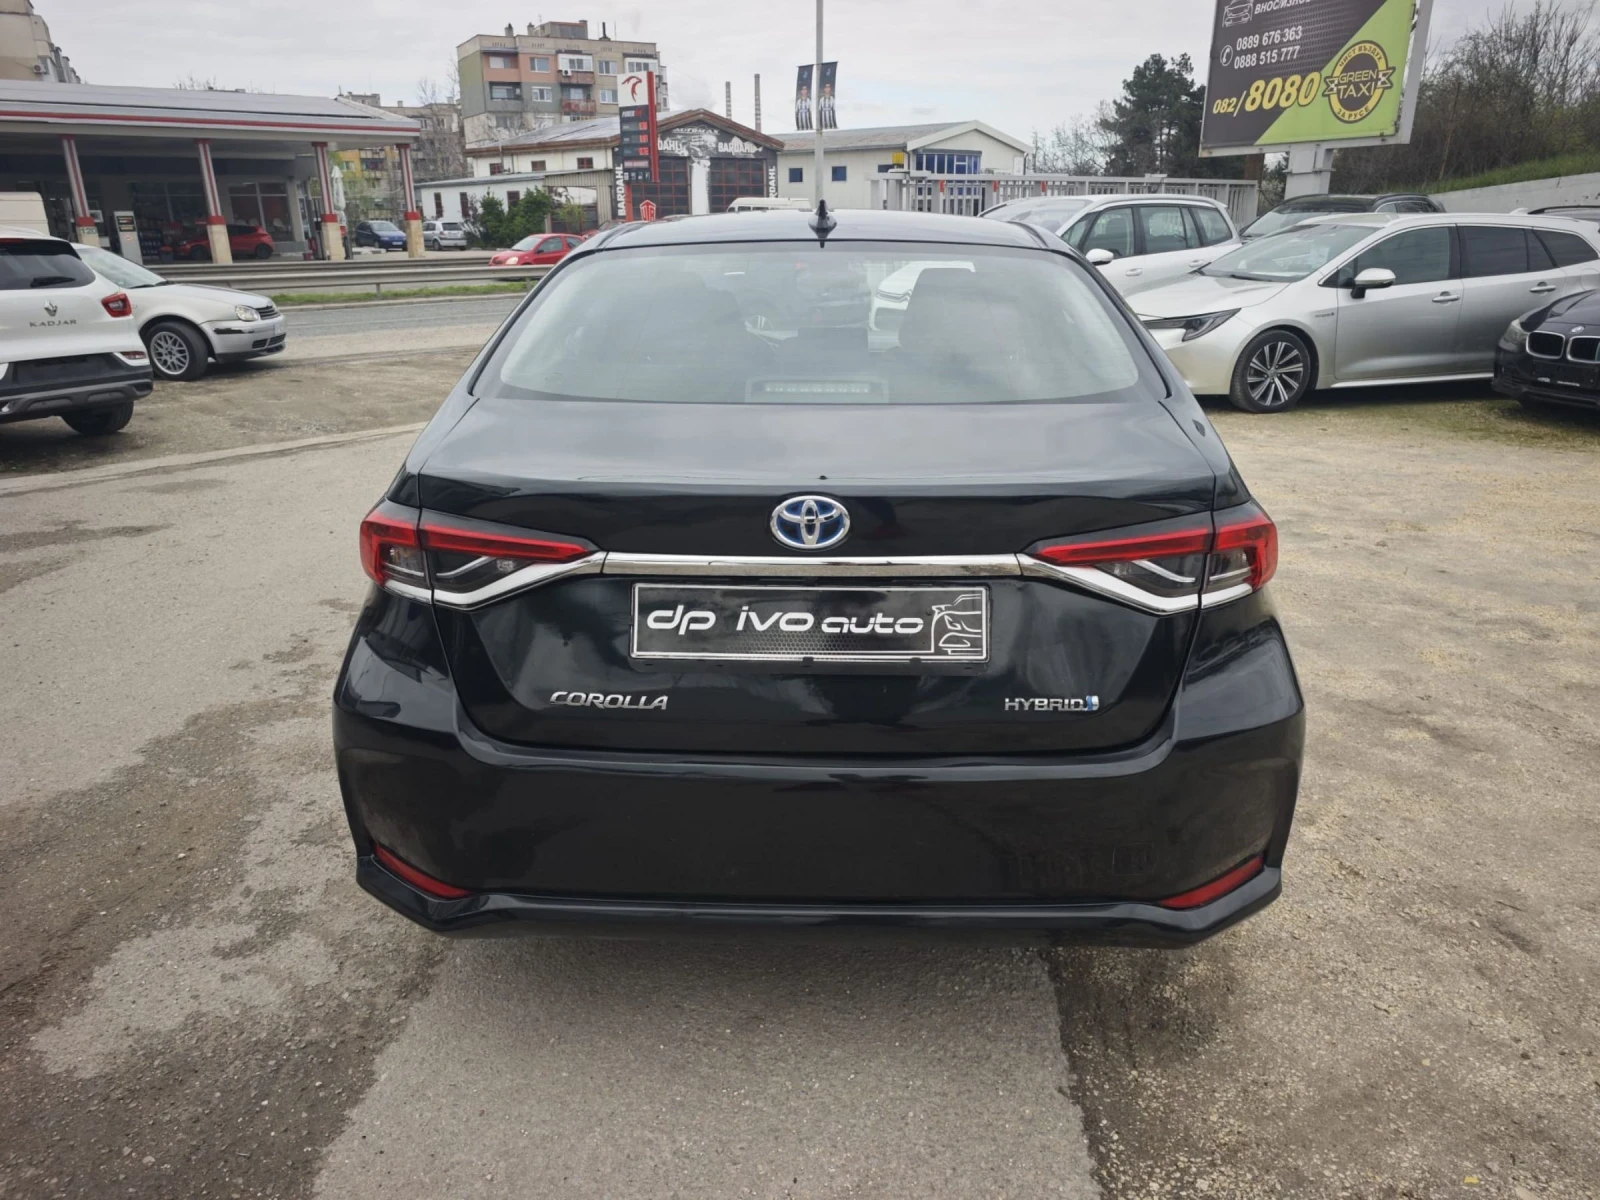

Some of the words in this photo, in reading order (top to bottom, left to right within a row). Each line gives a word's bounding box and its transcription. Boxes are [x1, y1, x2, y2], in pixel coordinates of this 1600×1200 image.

[1254, 0, 1311, 15] ВНОС/ИЗН
[1236, 34, 1259, 51] 0889
[1262, 30, 1281, 46] 676
[1283, 25, 1303, 42] 363
[1234, 53, 1257, 69] 0888
[1259, 49, 1278, 65] 515
[1280, 45, 1300, 61] 777
[1339, 69, 1378, 83] GREEN
[1338, 81, 1375, 99] TAXI
[718, 140, 757, 153] BARDAHL
[616, 164, 626, 216] BARDAHL
[29, 319, 77, 328] KADJAR
[647, 605, 716, 635] dp
[736, 606, 815, 632] ivo
[821, 612, 924, 634] auto
[549, 691, 669, 710] COROLLA
[1004, 697, 1088, 712] HYBRID
